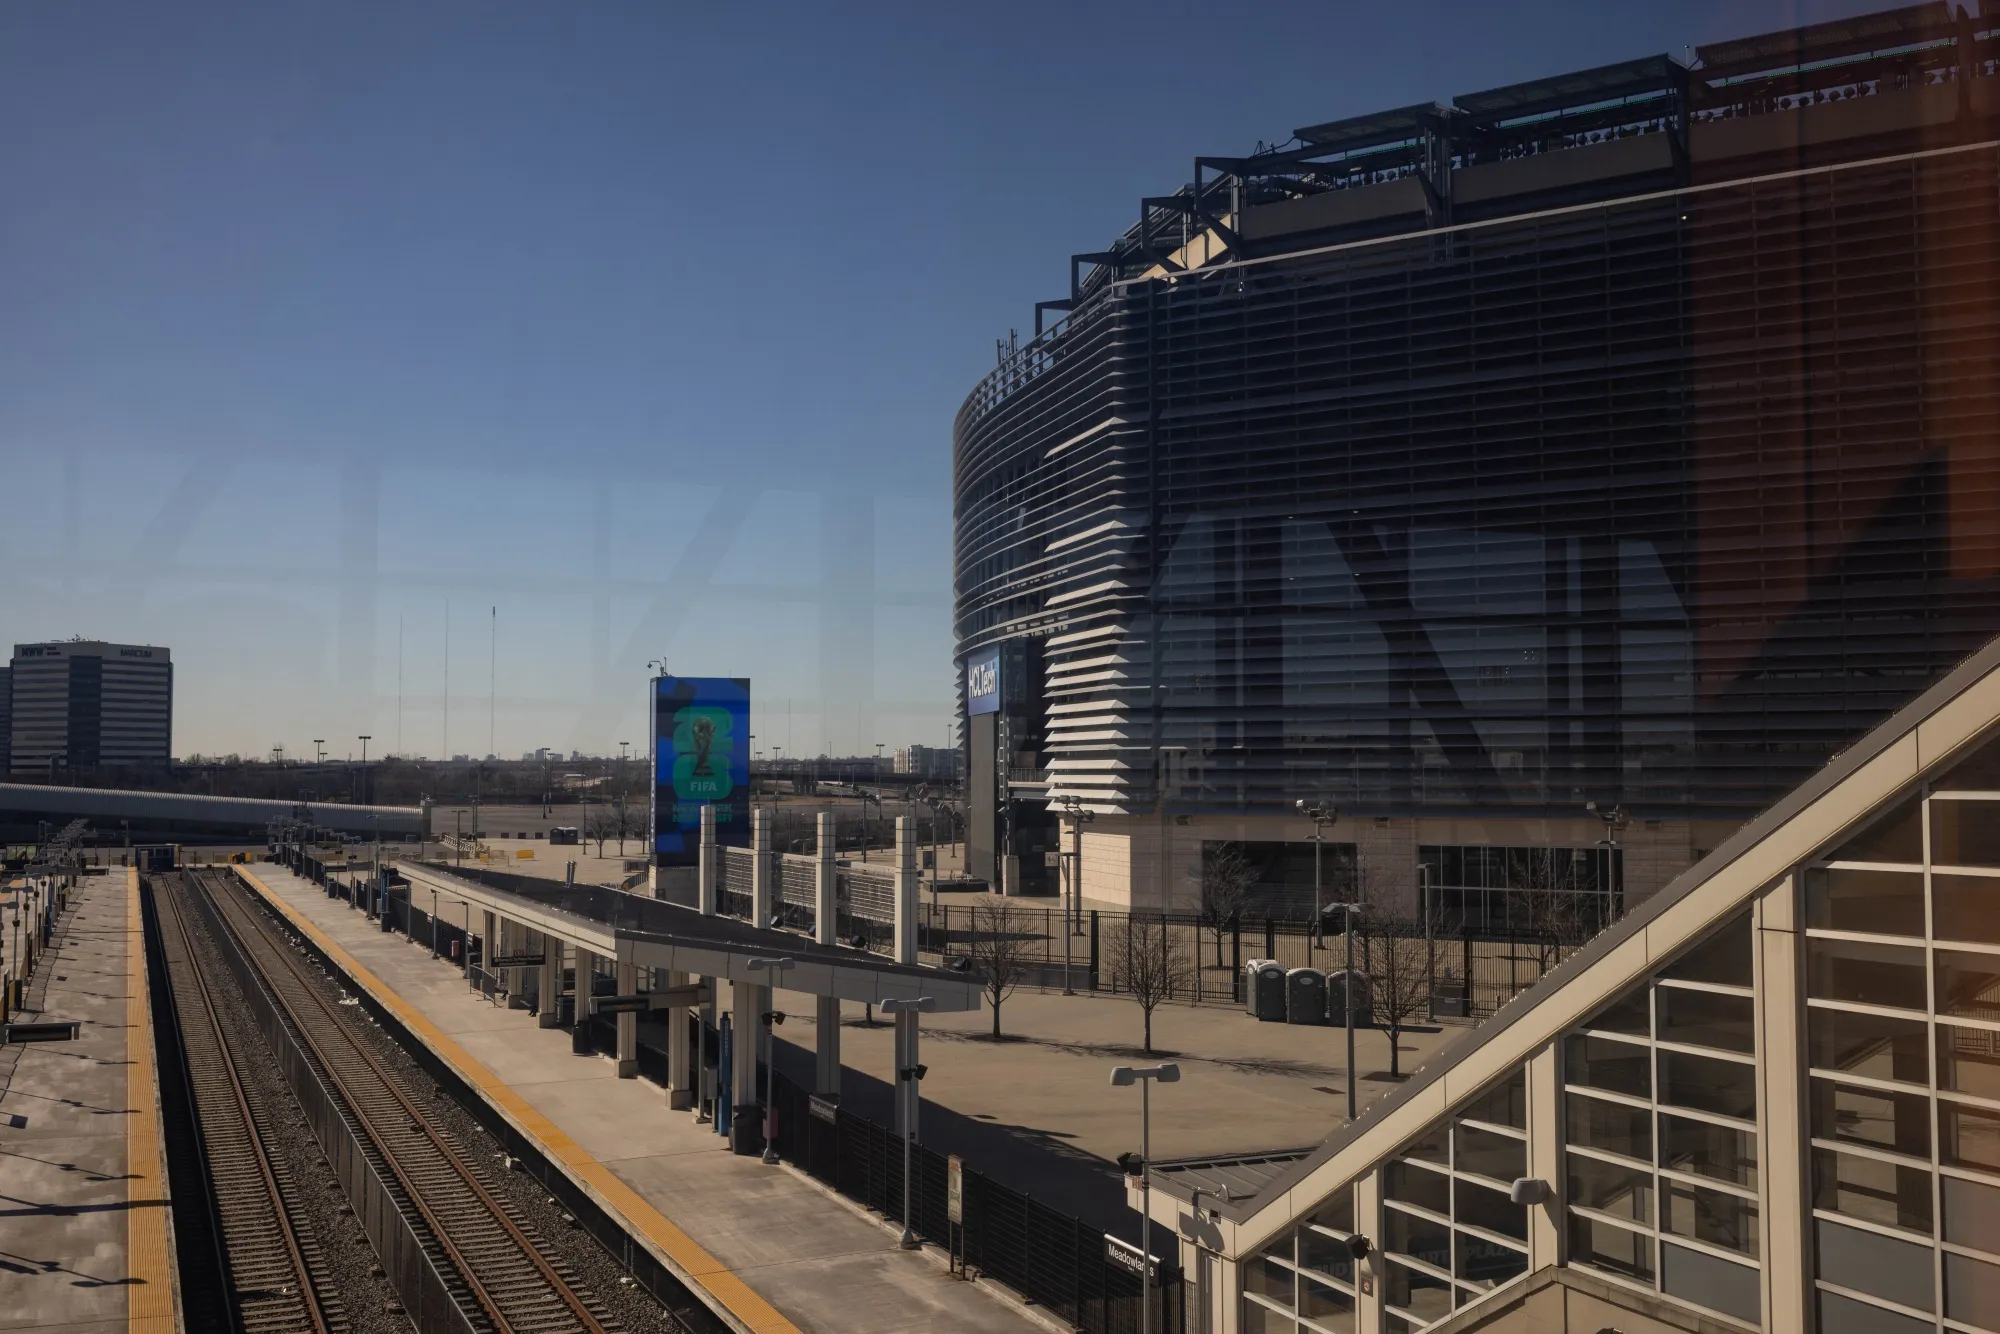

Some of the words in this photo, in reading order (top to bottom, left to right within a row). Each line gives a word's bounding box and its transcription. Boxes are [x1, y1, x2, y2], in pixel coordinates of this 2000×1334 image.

[968, 662, 996, 699] HCLTech
[690, 780, 717, 793] FIFA
[1108, 1243, 1155, 1277] Meadowlans
